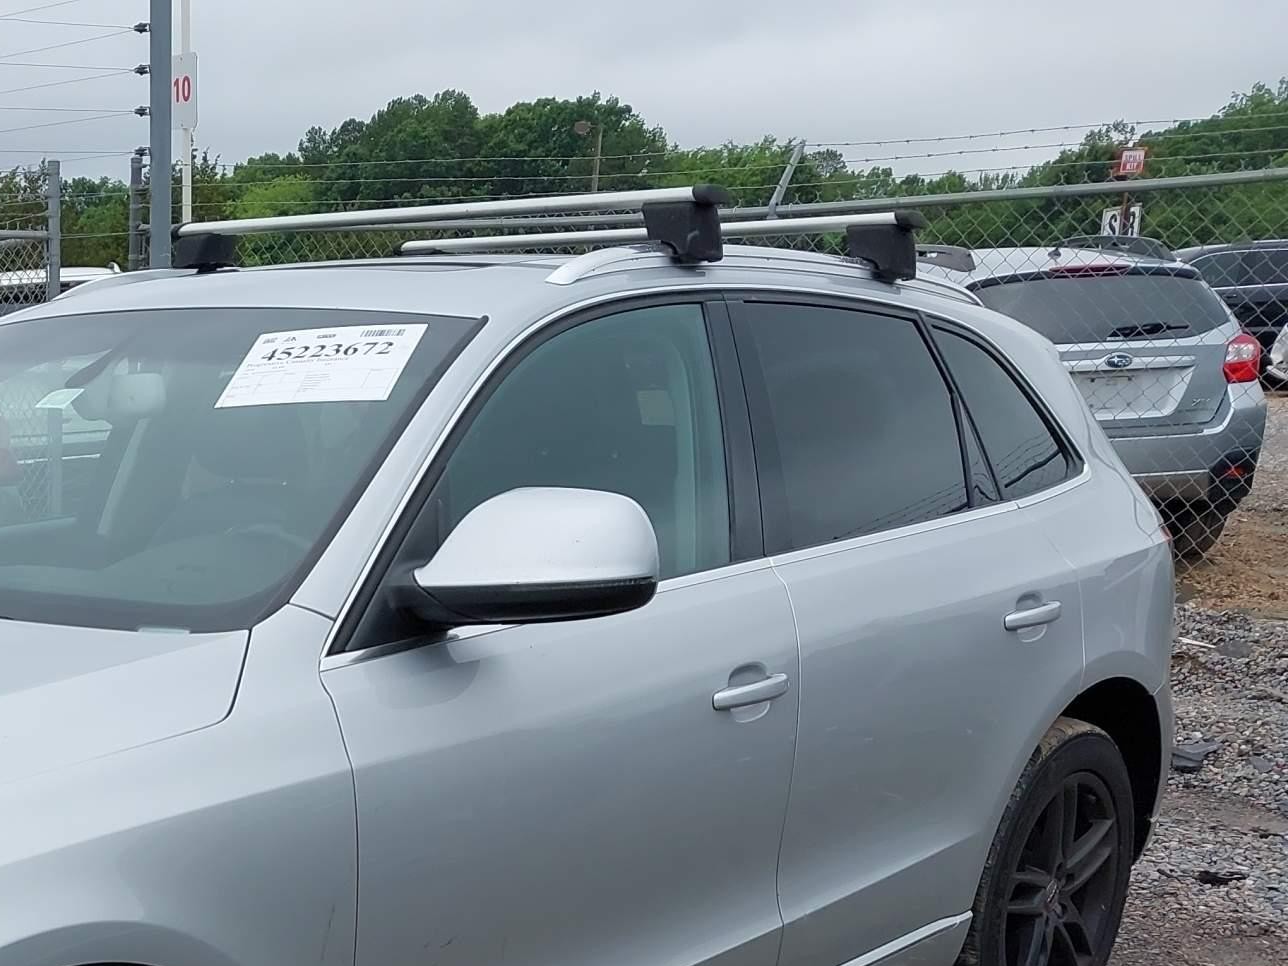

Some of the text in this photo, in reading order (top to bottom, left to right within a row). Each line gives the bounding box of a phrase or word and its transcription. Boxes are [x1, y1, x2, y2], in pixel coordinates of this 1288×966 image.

[173, 75, 191, 103] 10
[1125, 162, 1137, 170] KIT
[261, 341, 394, 361] 45223672
